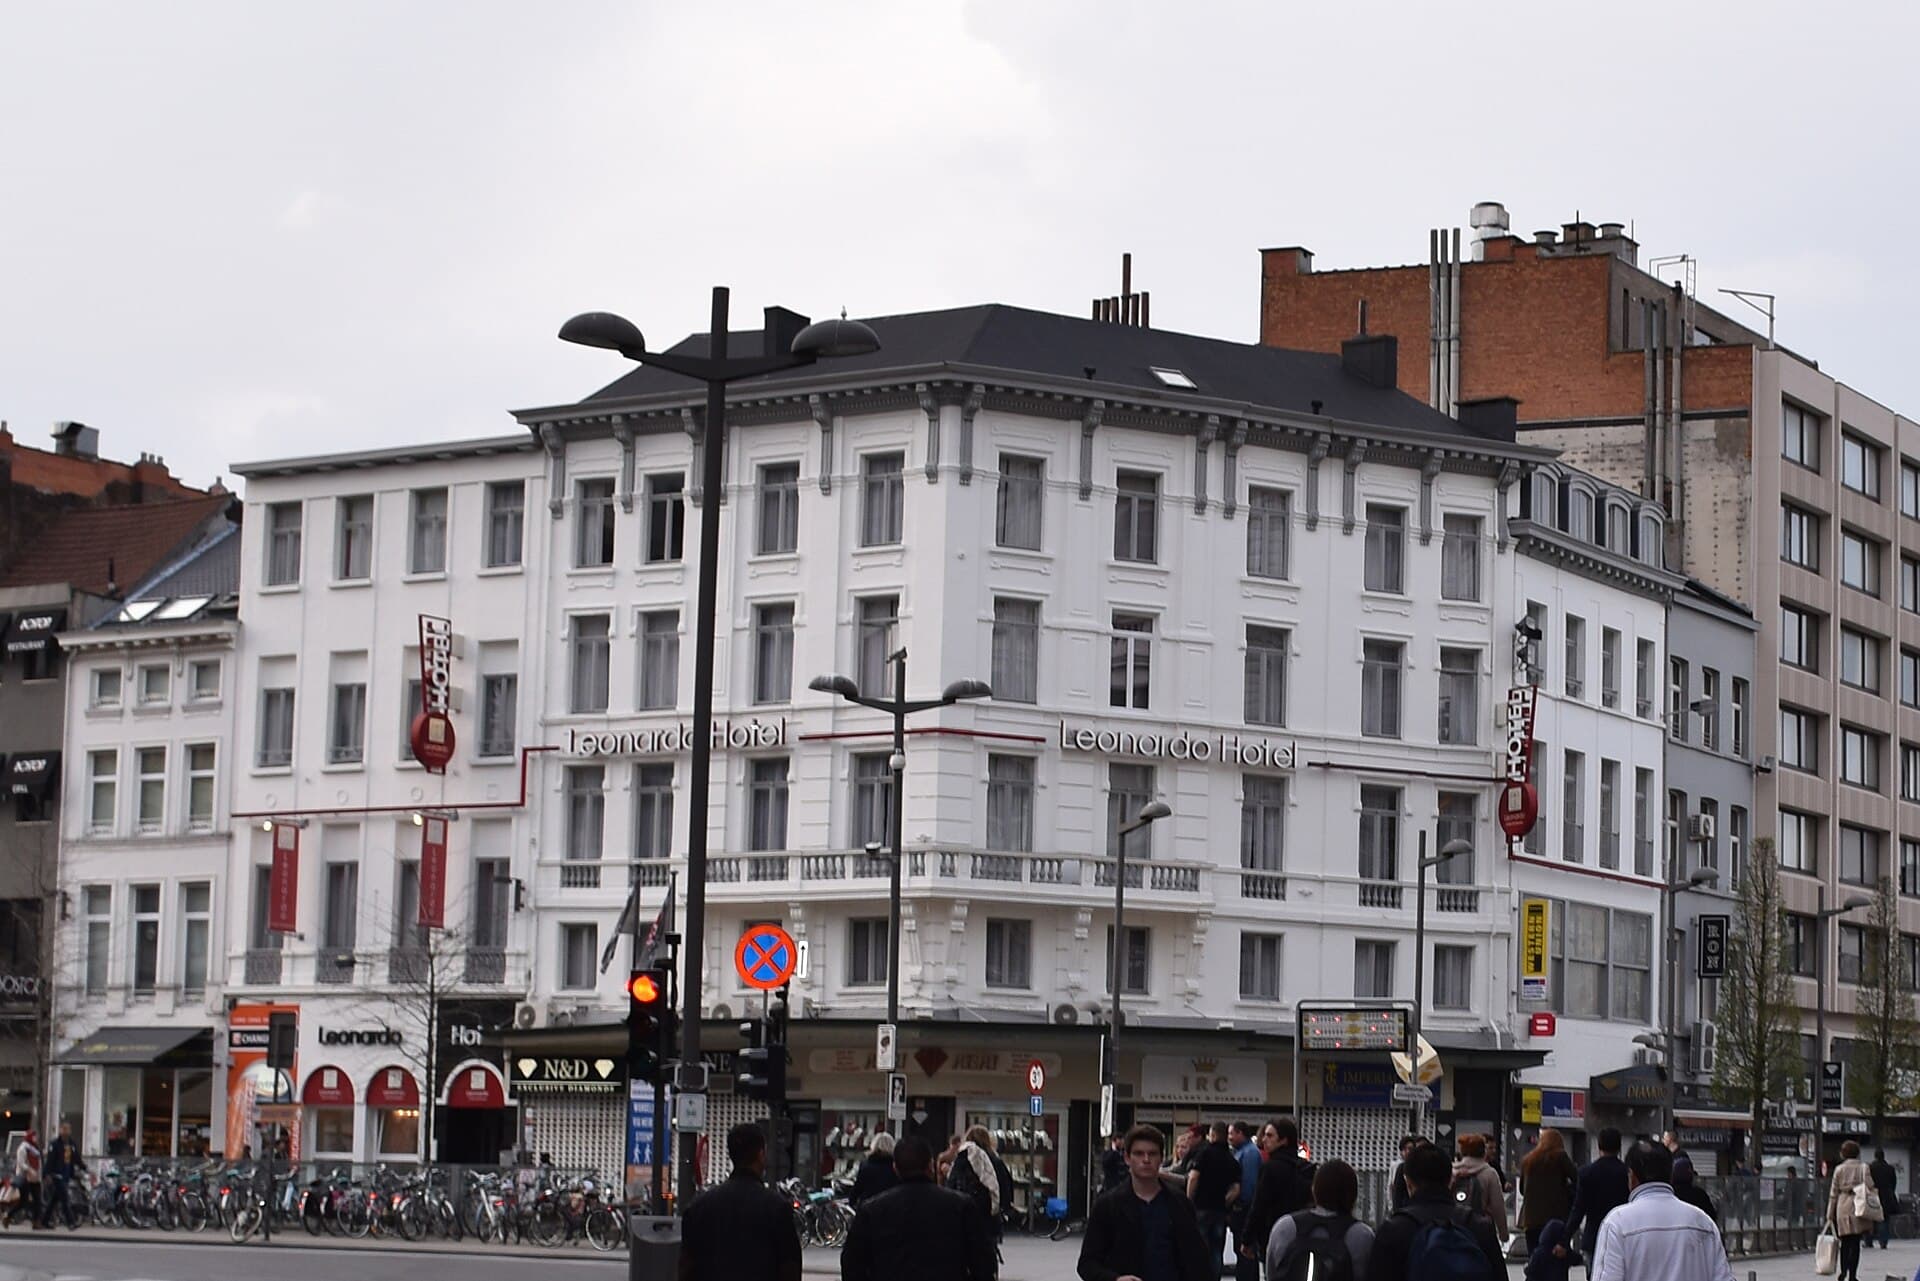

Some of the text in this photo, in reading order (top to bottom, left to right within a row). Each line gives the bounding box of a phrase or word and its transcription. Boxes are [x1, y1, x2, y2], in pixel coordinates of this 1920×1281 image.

[430, 617, 450, 713] HOTEL
[569, 717, 786, 756] Leonardo Hotel
[1060, 719, 1299, 769] Leonardo Hotel
[1507, 689, 1525, 781] HOTEL
[1527, 915, 1535, 973] WESTERN
[318, 1026, 403, 1046] Leonardo
[517, 1084, 615, 1093] EXCLUSIVE DIAMONDS
[543, 1059, 589, 1080] N&D
[1182, 1076, 1228, 1092] IRC
